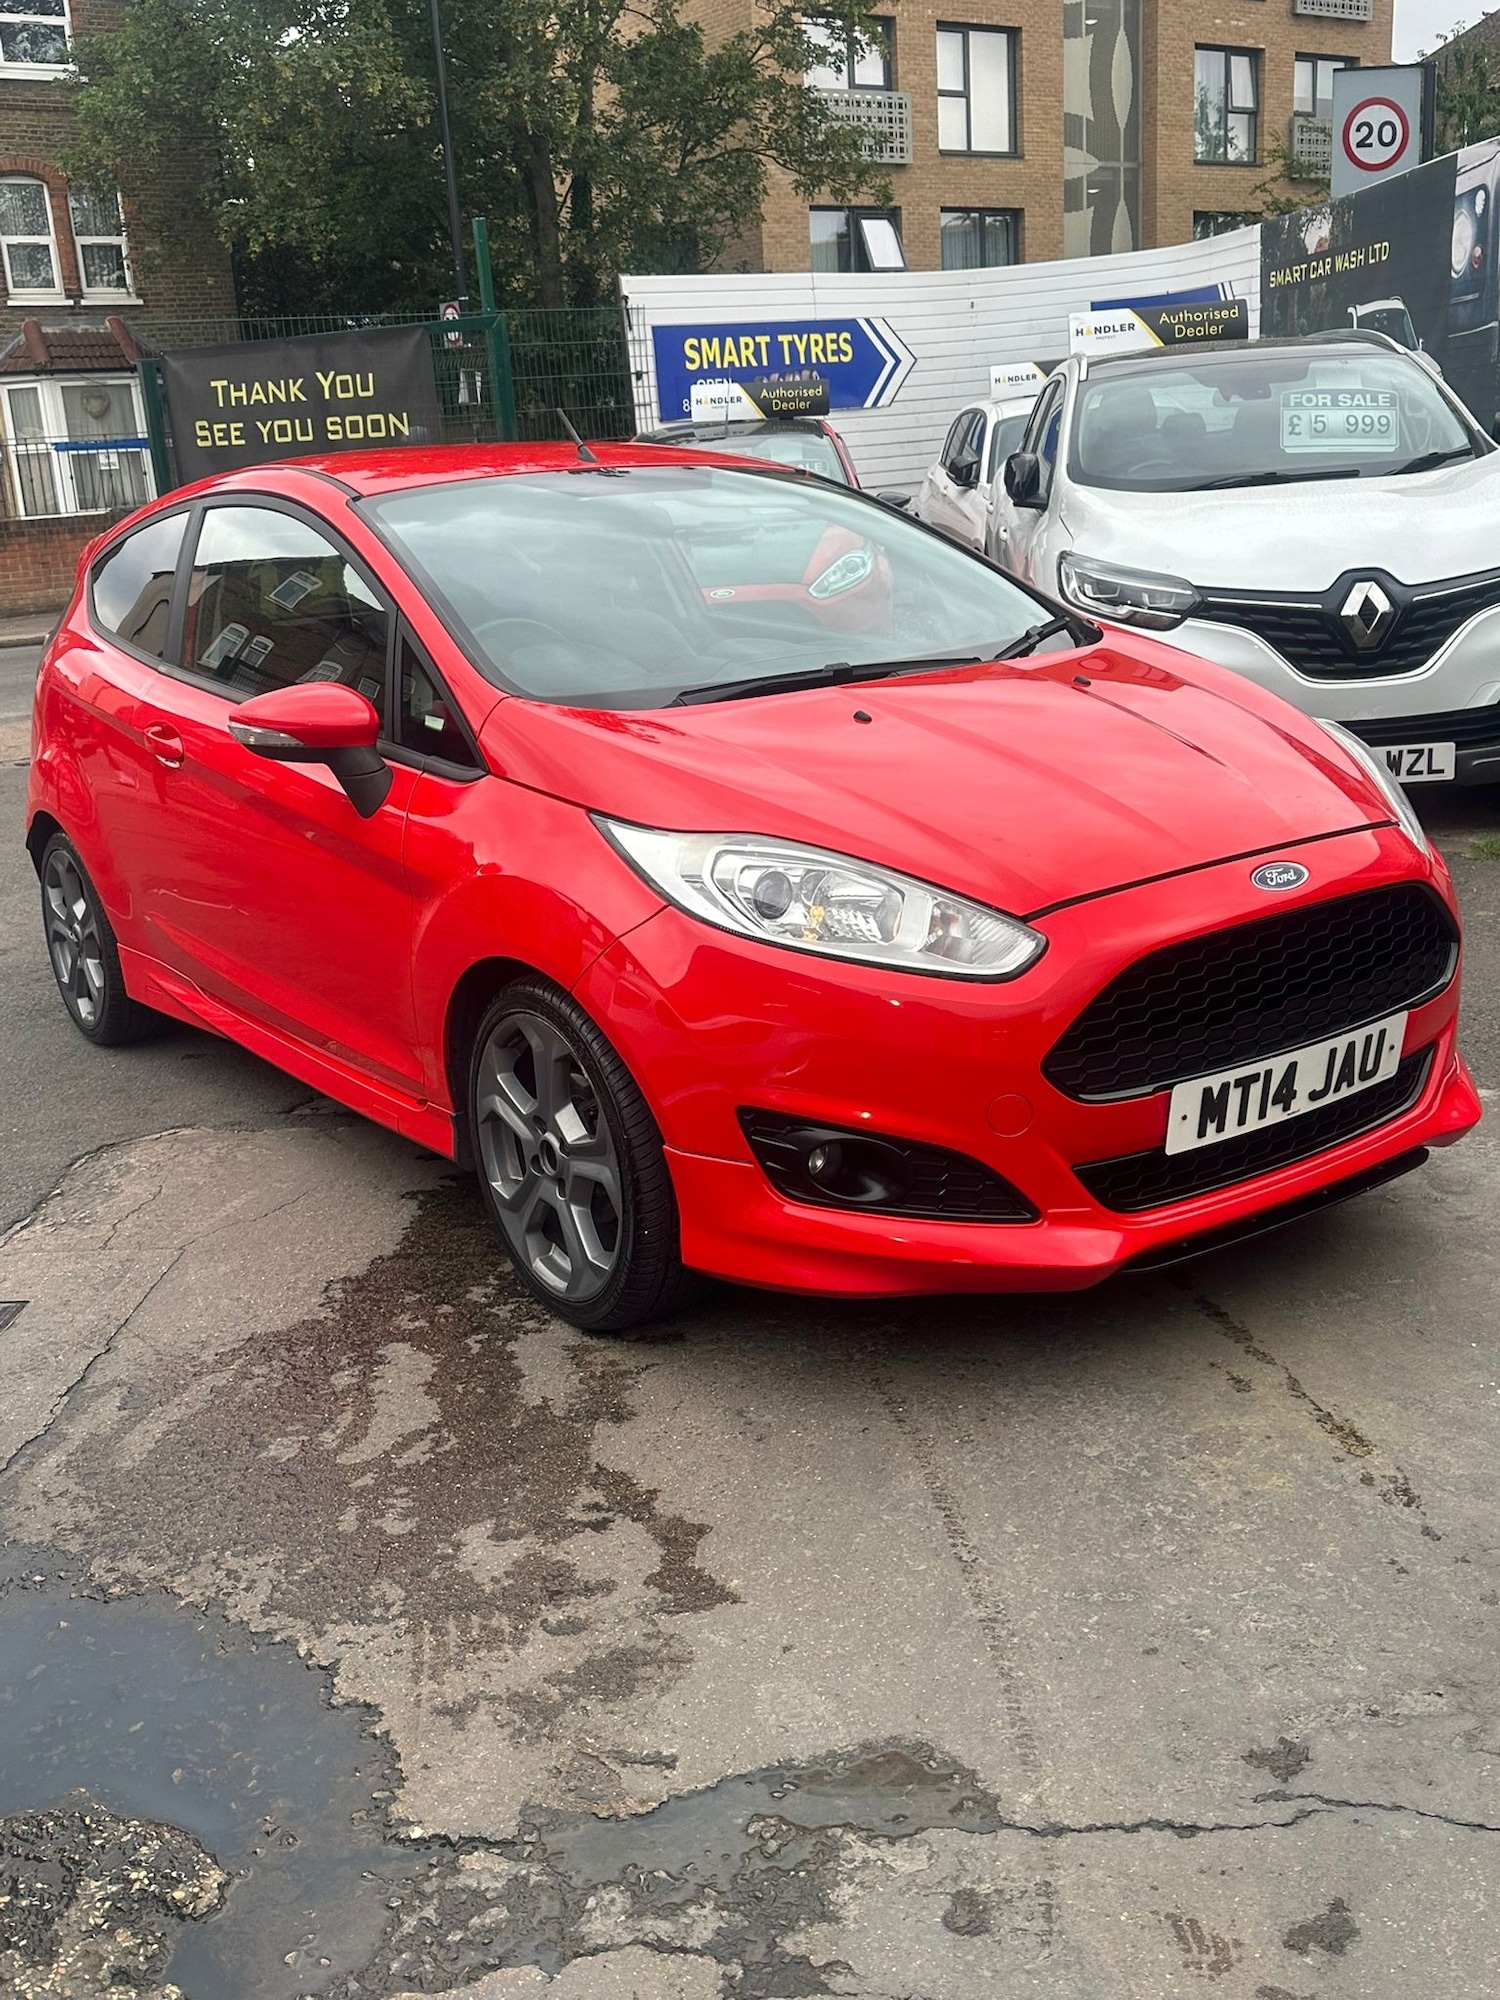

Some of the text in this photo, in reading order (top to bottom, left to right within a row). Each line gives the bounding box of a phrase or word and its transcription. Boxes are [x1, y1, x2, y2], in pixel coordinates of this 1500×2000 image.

[1355, 120, 1397, 149] 20
[1269, 241, 1390, 288] SMART CAR WASH LTD
[1159, 304, 1239, 325] Authorised
[1174, 321, 1224, 339] Dealer
[683, 331, 854, 371] SMART TYRES
[210, 370, 375, 408] THANK YOU
[760, 384, 823, 399] Authorised
[1289, 393, 1391, 407] FOR SALE
[772, 398, 811, 411] Dealer
[194, 412, 410, 448] SEE YOU SOON
[1287, 414, 1391, 436] £ 5 999
[1386, 747, 1445, 777] WZL
[1264, 867, 1298, 886] Ford
[1197, 1027, 1388, 1140] MT14 JAU
